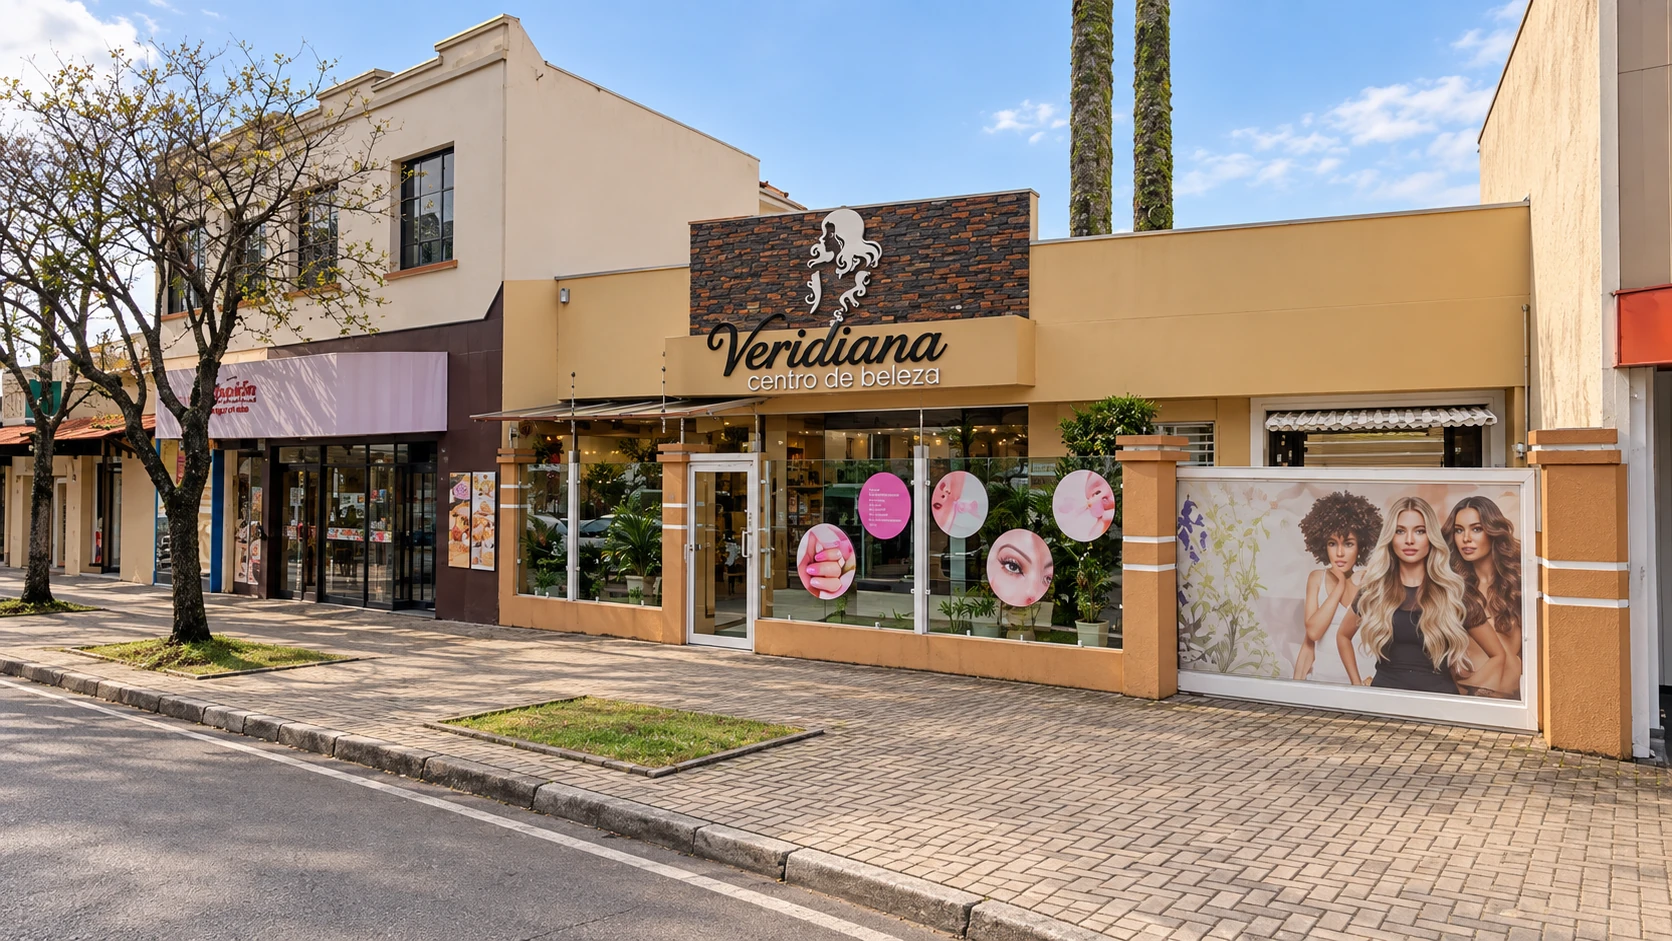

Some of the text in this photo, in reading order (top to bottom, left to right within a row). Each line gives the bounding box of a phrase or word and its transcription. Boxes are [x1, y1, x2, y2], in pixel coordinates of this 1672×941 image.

[707, 313, 948, 377] Veridiana
[748, 364, 940, 391] centro de beleza
